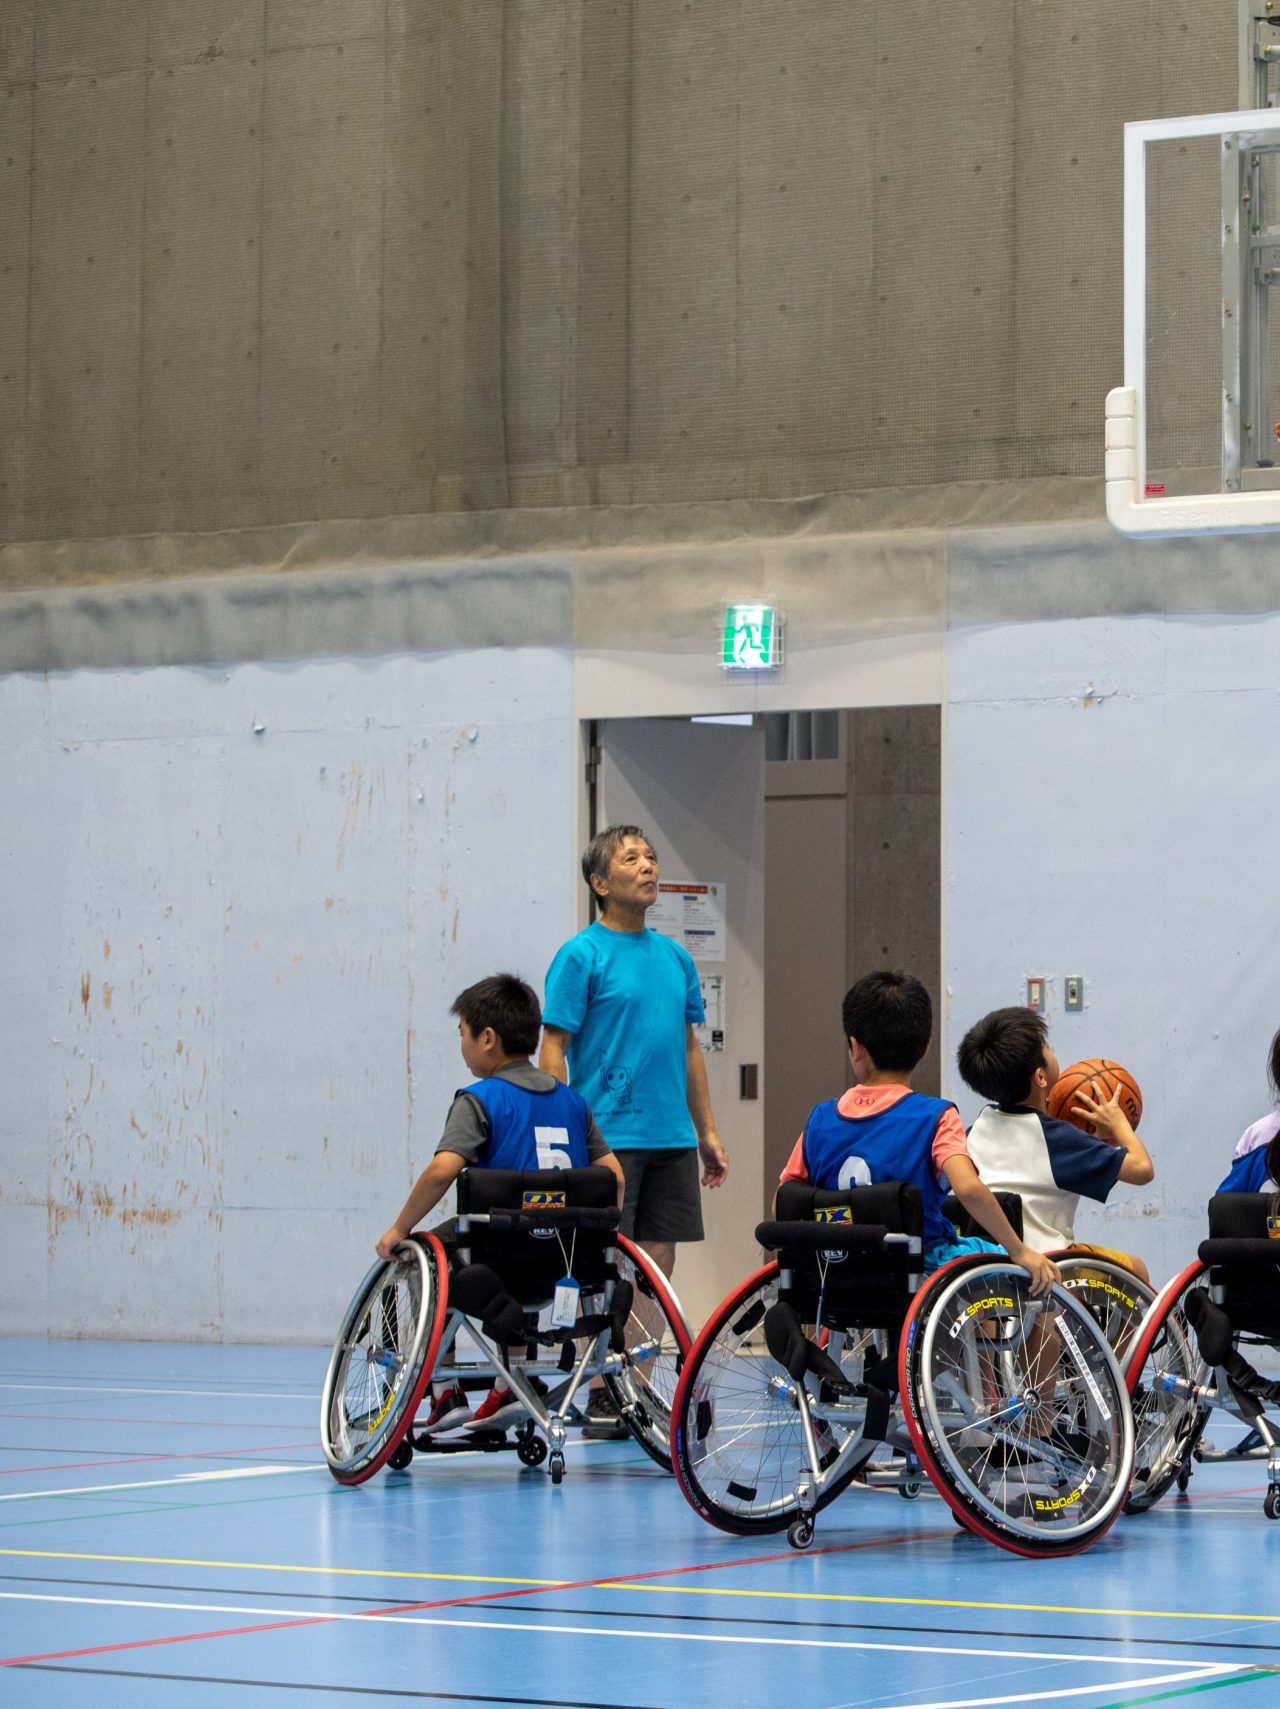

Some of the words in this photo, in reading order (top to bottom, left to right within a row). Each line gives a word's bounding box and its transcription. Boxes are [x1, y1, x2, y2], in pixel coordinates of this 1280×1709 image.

[1062, 1278, 1089, 1290] OX
[1088, 1279, 1135, 1309] SPORTS
[949, 1310, 971, 1339] OX
[966, 1297, 1014, 1316] SPORTS
[1077, 1465, 1097, 1495] OX
[1035, 1488, 1081, 1511] SPORTS
